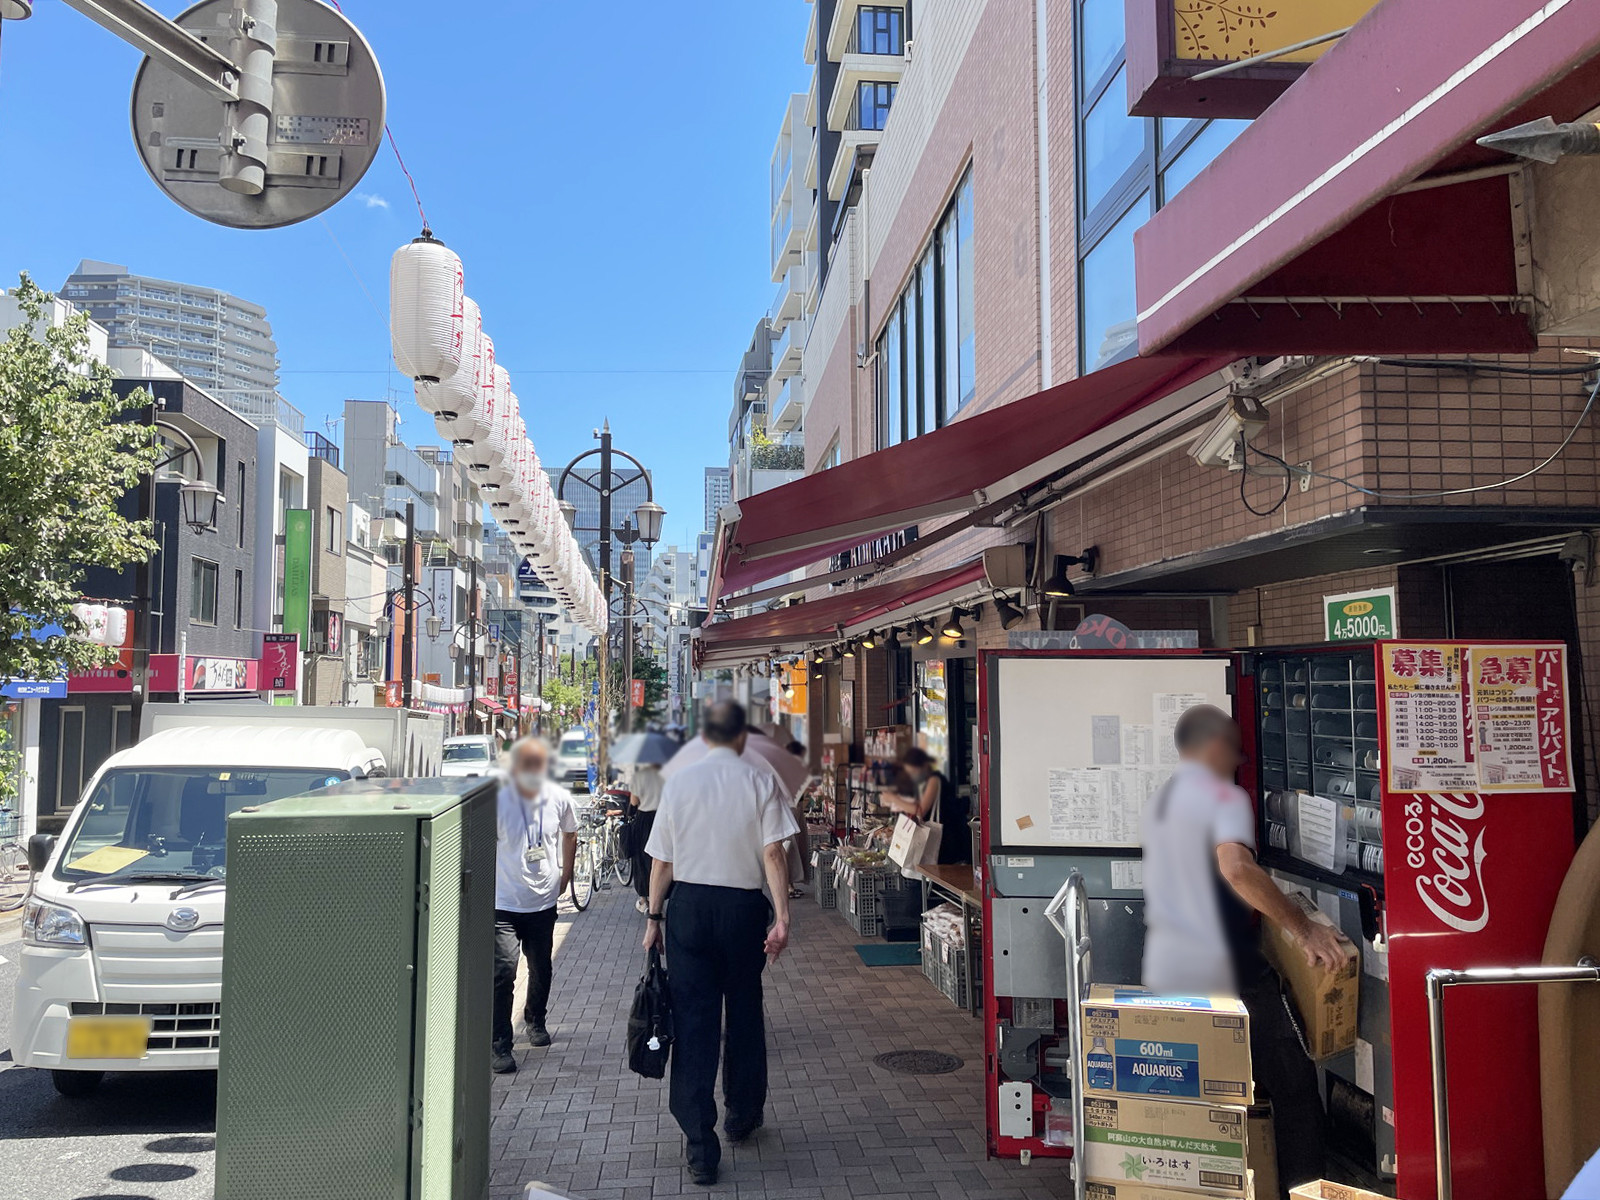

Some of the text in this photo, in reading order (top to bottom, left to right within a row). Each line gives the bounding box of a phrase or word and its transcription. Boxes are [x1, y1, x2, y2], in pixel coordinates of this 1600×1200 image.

[1391, 648, 1445, 677] 募集
[1479, 656, 1532, 685] 急募
[1139, 1042, 1173, 1057] 600ml
[1087, 1060, 1113, 1069] AQUARIUS
[1132, 1062, 1184, 1077] AQUARIUS
